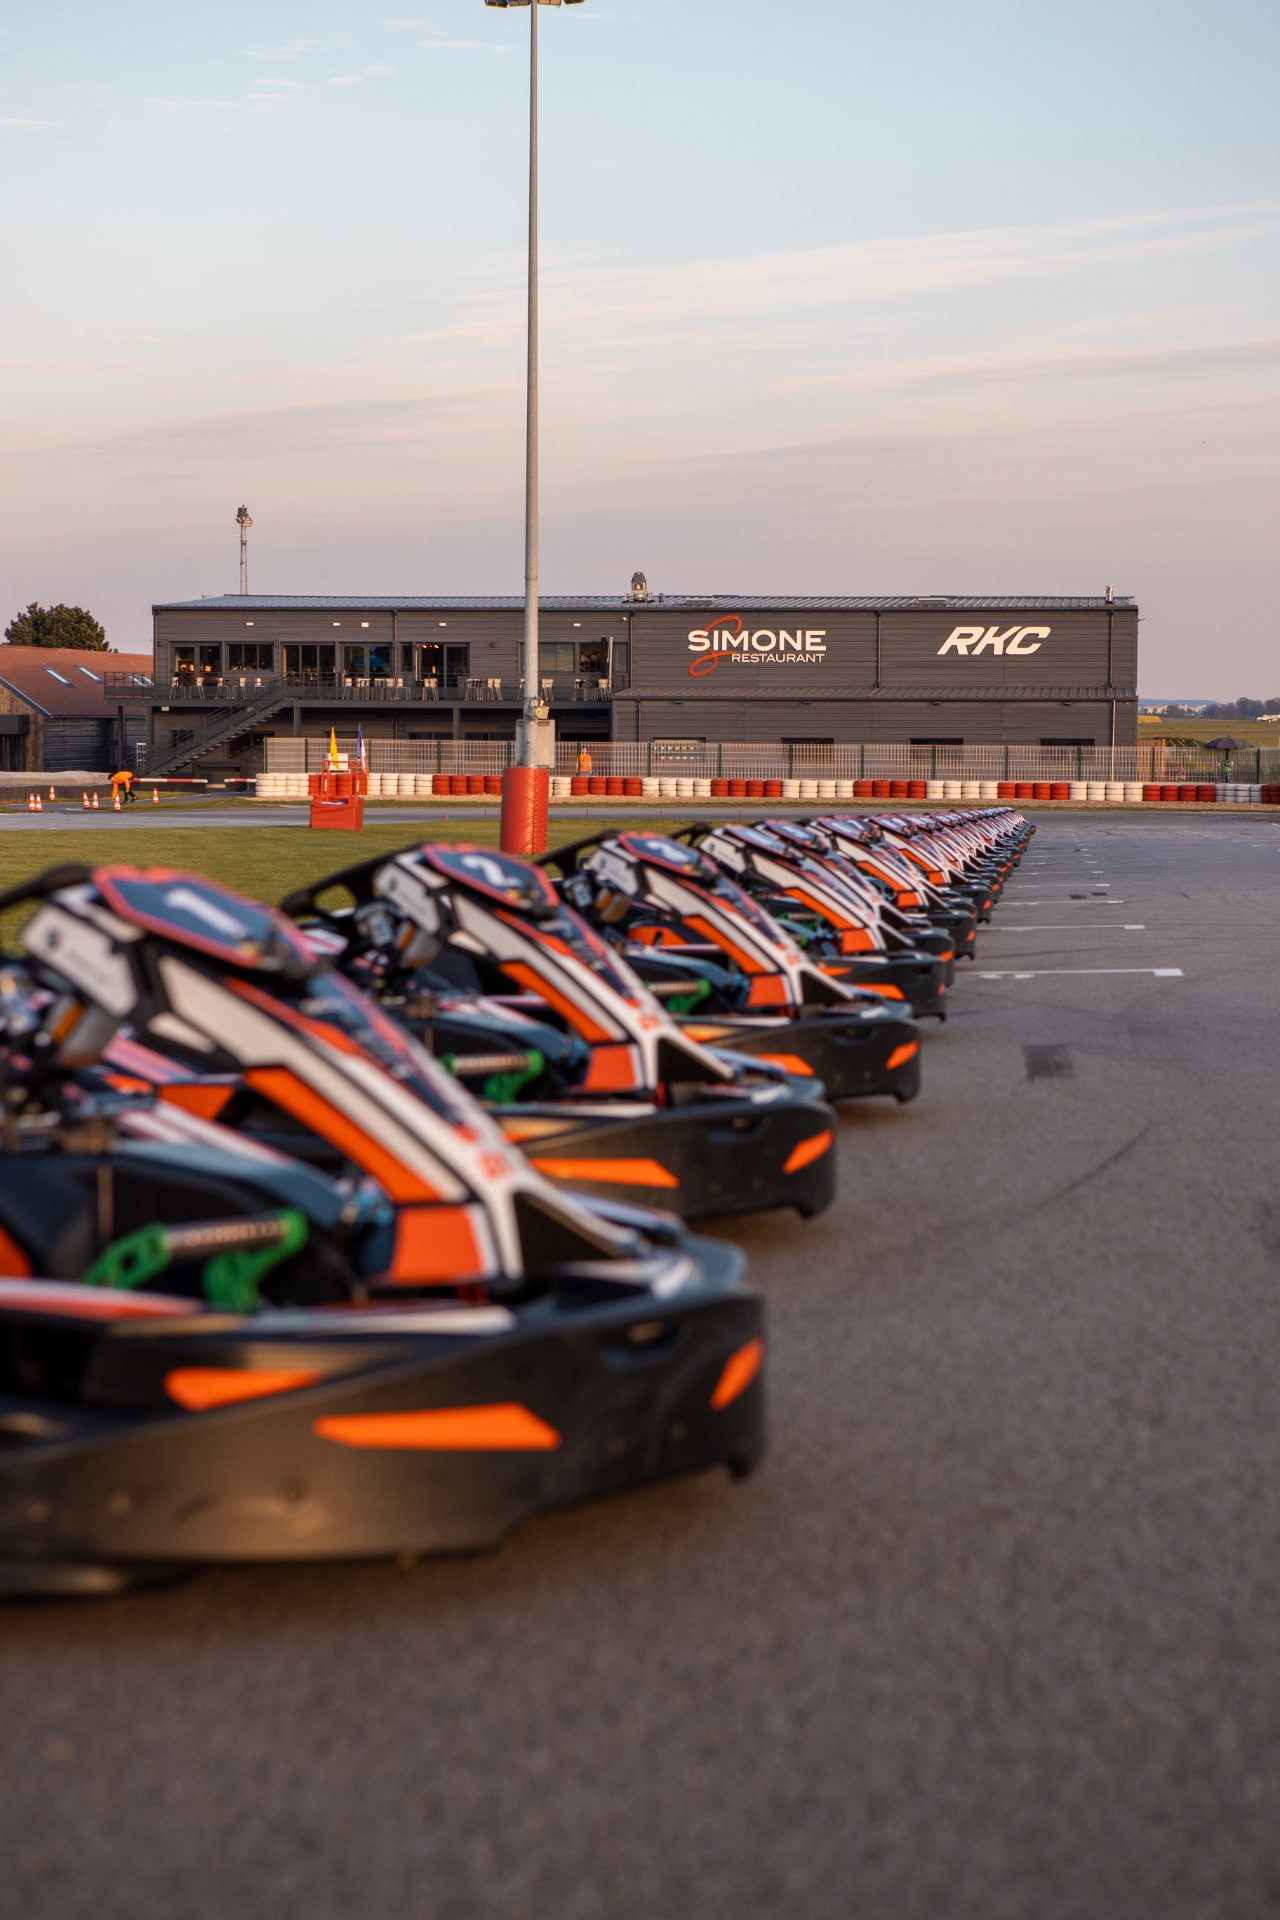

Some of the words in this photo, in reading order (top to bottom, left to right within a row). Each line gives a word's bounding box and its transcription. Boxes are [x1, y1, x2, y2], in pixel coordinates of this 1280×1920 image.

[688, 629, 827, 651] SIMONE
[936, 626, 1052, 655] RKC
[731, 653, 825, 663] RESTAURANT
[460, 854, 522, 888] 2
[163, 887, 248, 940] 1
